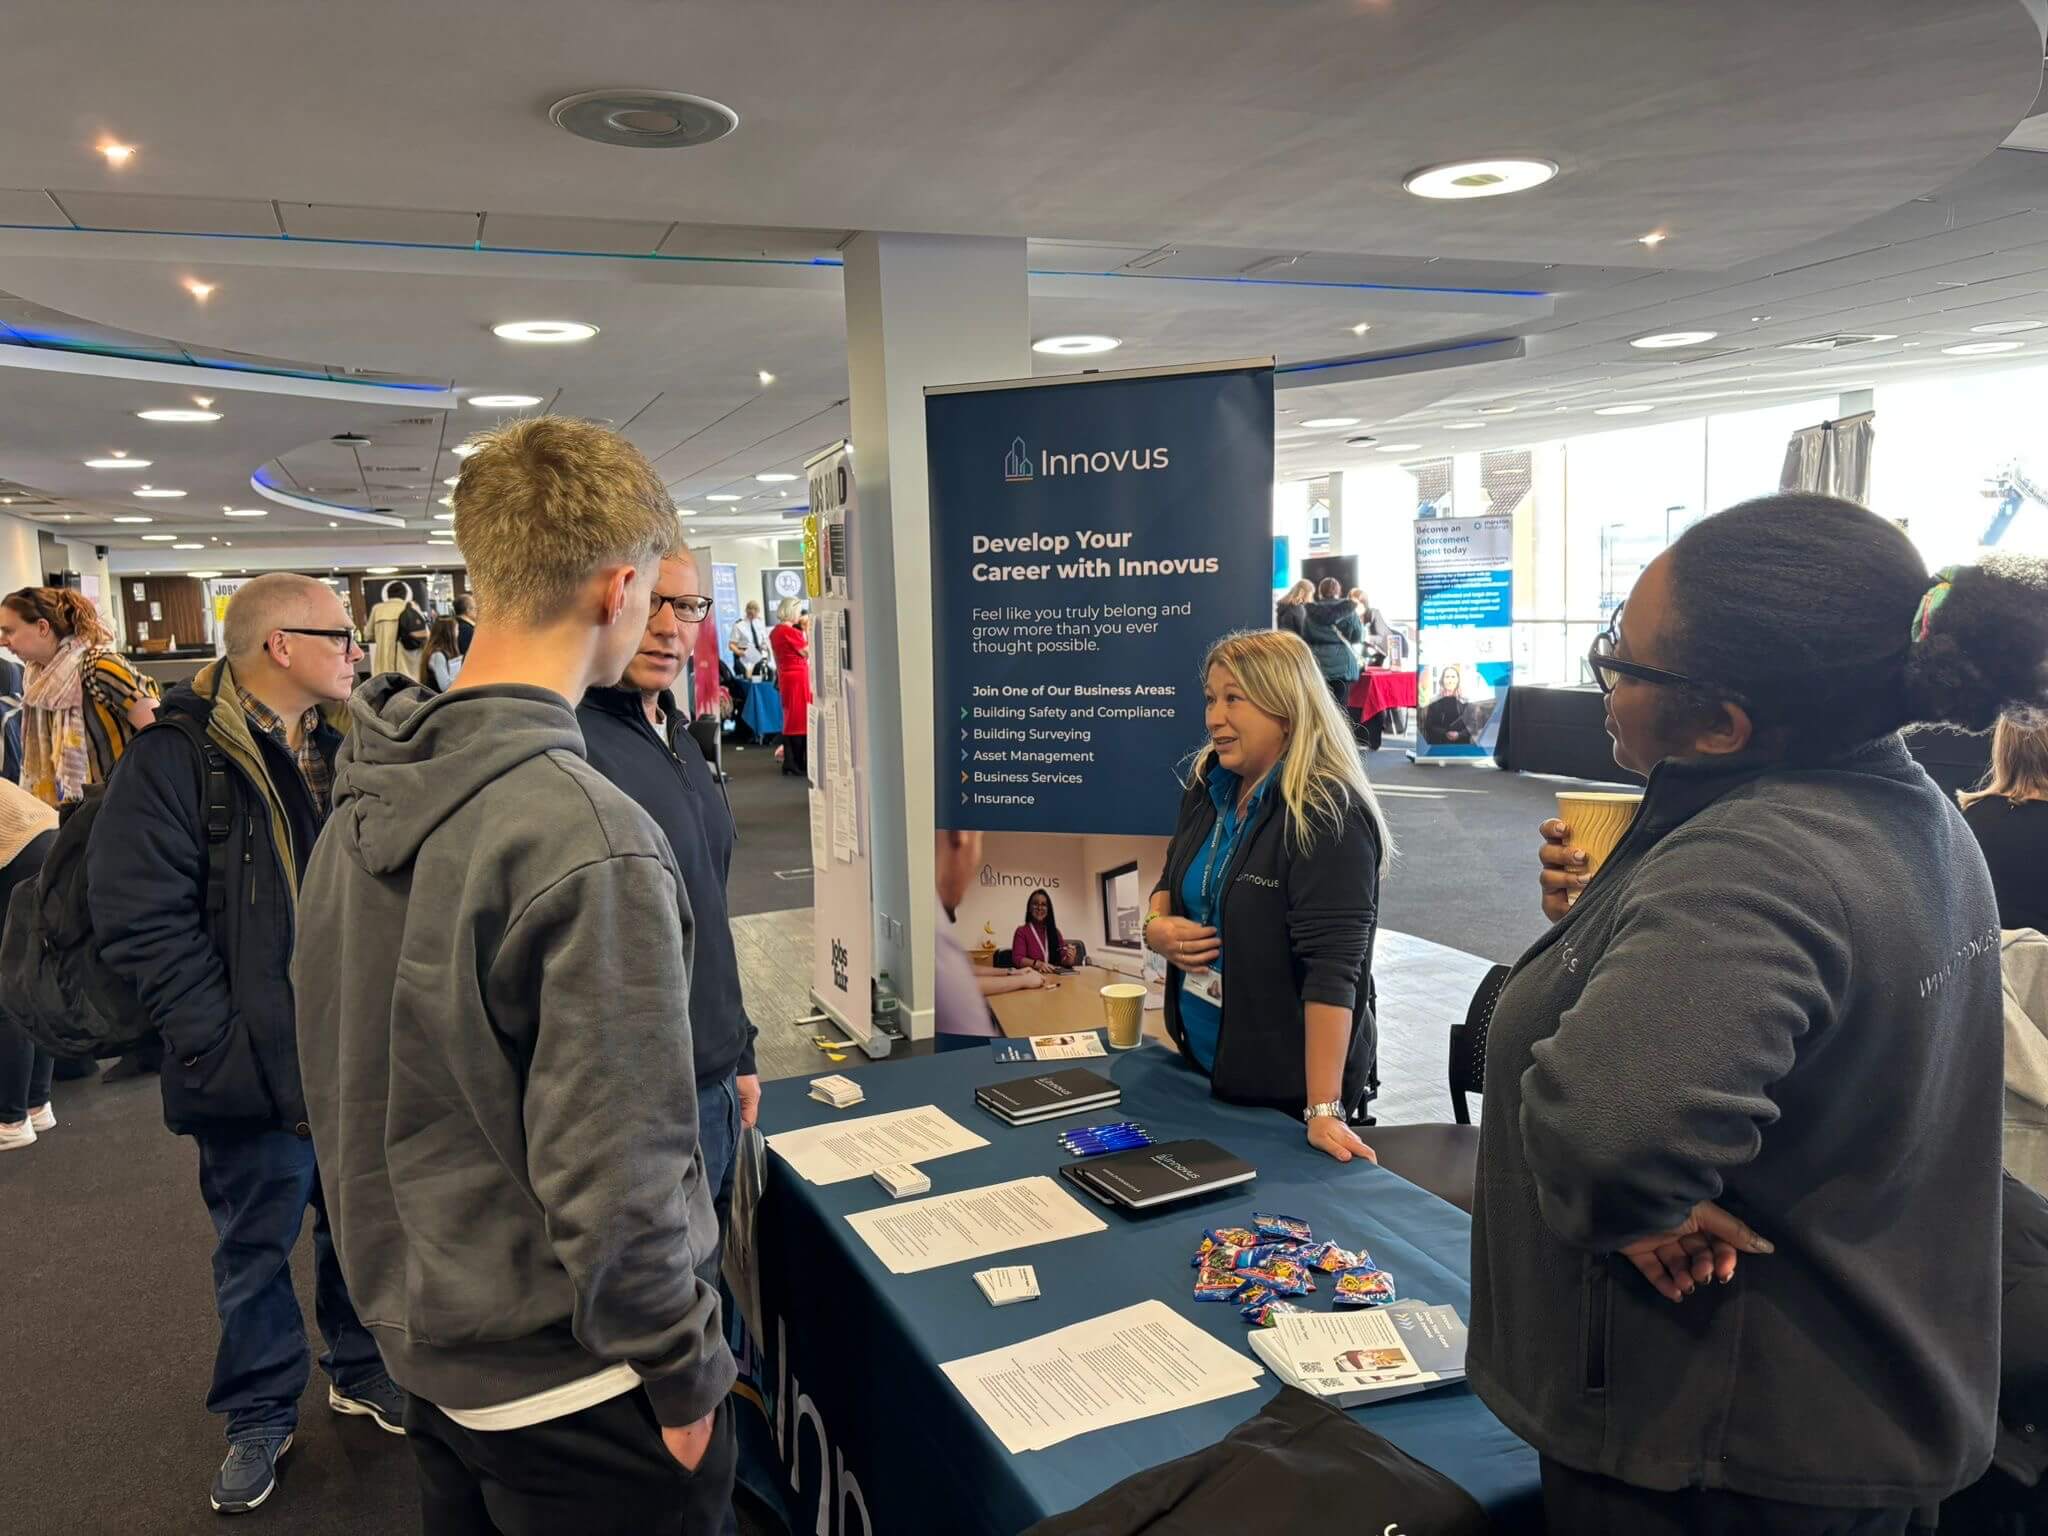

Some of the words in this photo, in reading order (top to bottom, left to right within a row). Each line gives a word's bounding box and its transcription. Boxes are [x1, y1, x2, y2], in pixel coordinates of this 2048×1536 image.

[1042, 447, 1169, 476] Innovus
[1416, 526, 1449, 534] Become
[972, 532, 1070, 555] Develop
[1075, 530, 1133, 549] Your
[1416, 536, 1470, 545] Enforcement
[1416, 547, 1441, 556] Agent
[1443, 546, 1467, 555] today
[972, 562, 1050, 581] Career
[1057, 557, 1111, 579] with
[1119, 557, 1219, 577] Innovus
[972, 607, 1002, 620] Feel
[1006, 607, 1032, 620] like
[1035, 610, 1062, 622] you
[1066, 605, 1100, 621] truly
[1103, 604, 1157, 619] belong
[1161, 602, 1191, 616] and
[972, 625, 1009, 640] grow
[1013, 625, 1053, 636] more
[1056, 622, 1090, 635] than
[1094, 623, 1122, 637] you
[1126, 622, 1159, 633] ever
[972, 640, 1033, 656] thought
[1037, 638, 1100, 655] possible.
[973, 686, 998, 697] Join
[1002, 686, 1028, 696] One
[1031, 685, 1045, 696] of
[1047, 685, 1071, 696] Our
[1074, 685, 1131, 696] Business
[1134, 684, 1176, 695] Areas:
[973, 707, 1026, 720] Building
[1029, 706, 1067, 720] Safety
[1070, 706, 1094, 718] and
[1097, 706, 1176, 720] Compliance
[973, 728, 1026, 741] Building
[1029, 728, 1091, 742] Surveying
[973, 750, 1007, 761] Asset
[1010, 750, 1095, 764] Management
[974, 771, 1029, 782] Business
[1031, 772, 1083, 783] Services
[974, 793, 1035, 804] Insurance
[997, 871, 1060, 888] Innovus
